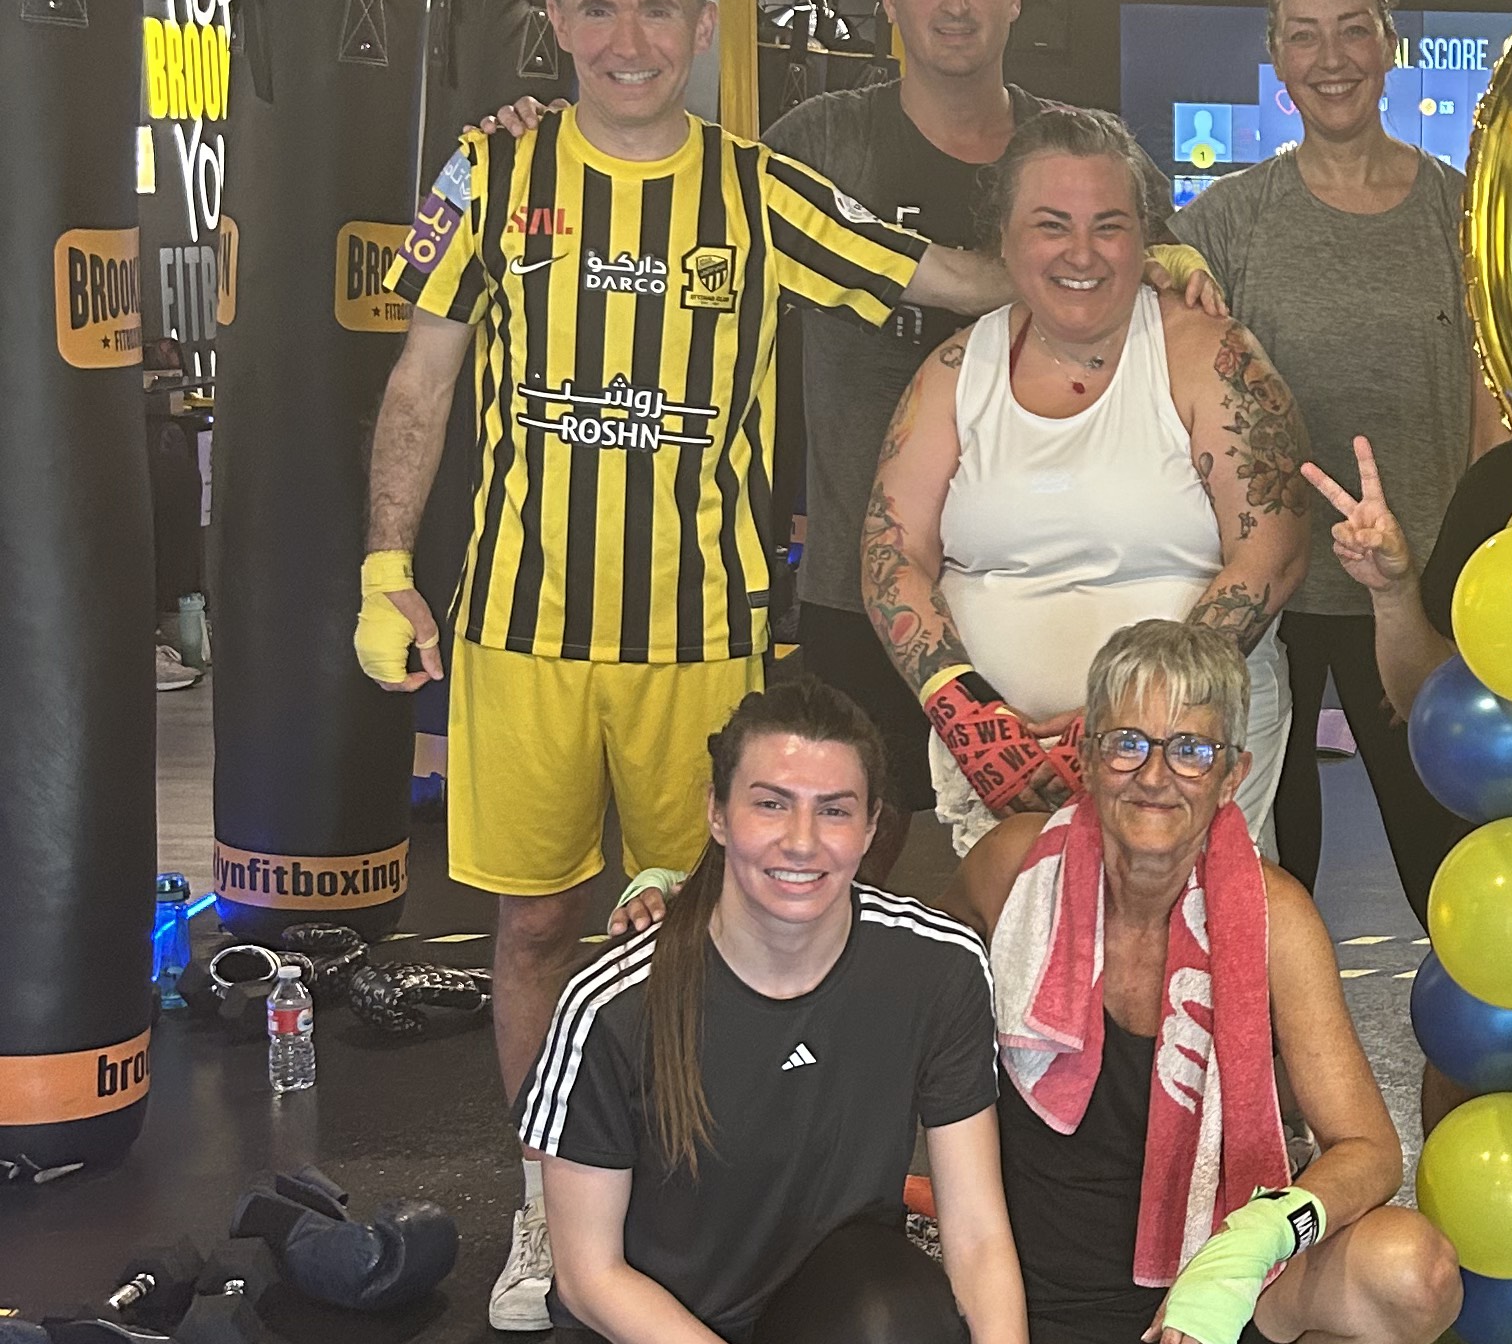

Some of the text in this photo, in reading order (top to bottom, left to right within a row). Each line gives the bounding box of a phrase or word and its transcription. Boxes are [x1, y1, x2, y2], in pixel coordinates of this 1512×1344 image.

[1419, 38, 1489, 70] SCORE
[347, 234, 400, 300] BRO
[586, 274, 667, 293] DARCO
[562, 415, 660, 449] ROSHN
[214, 845, 409, 894] lynfitboxing.
